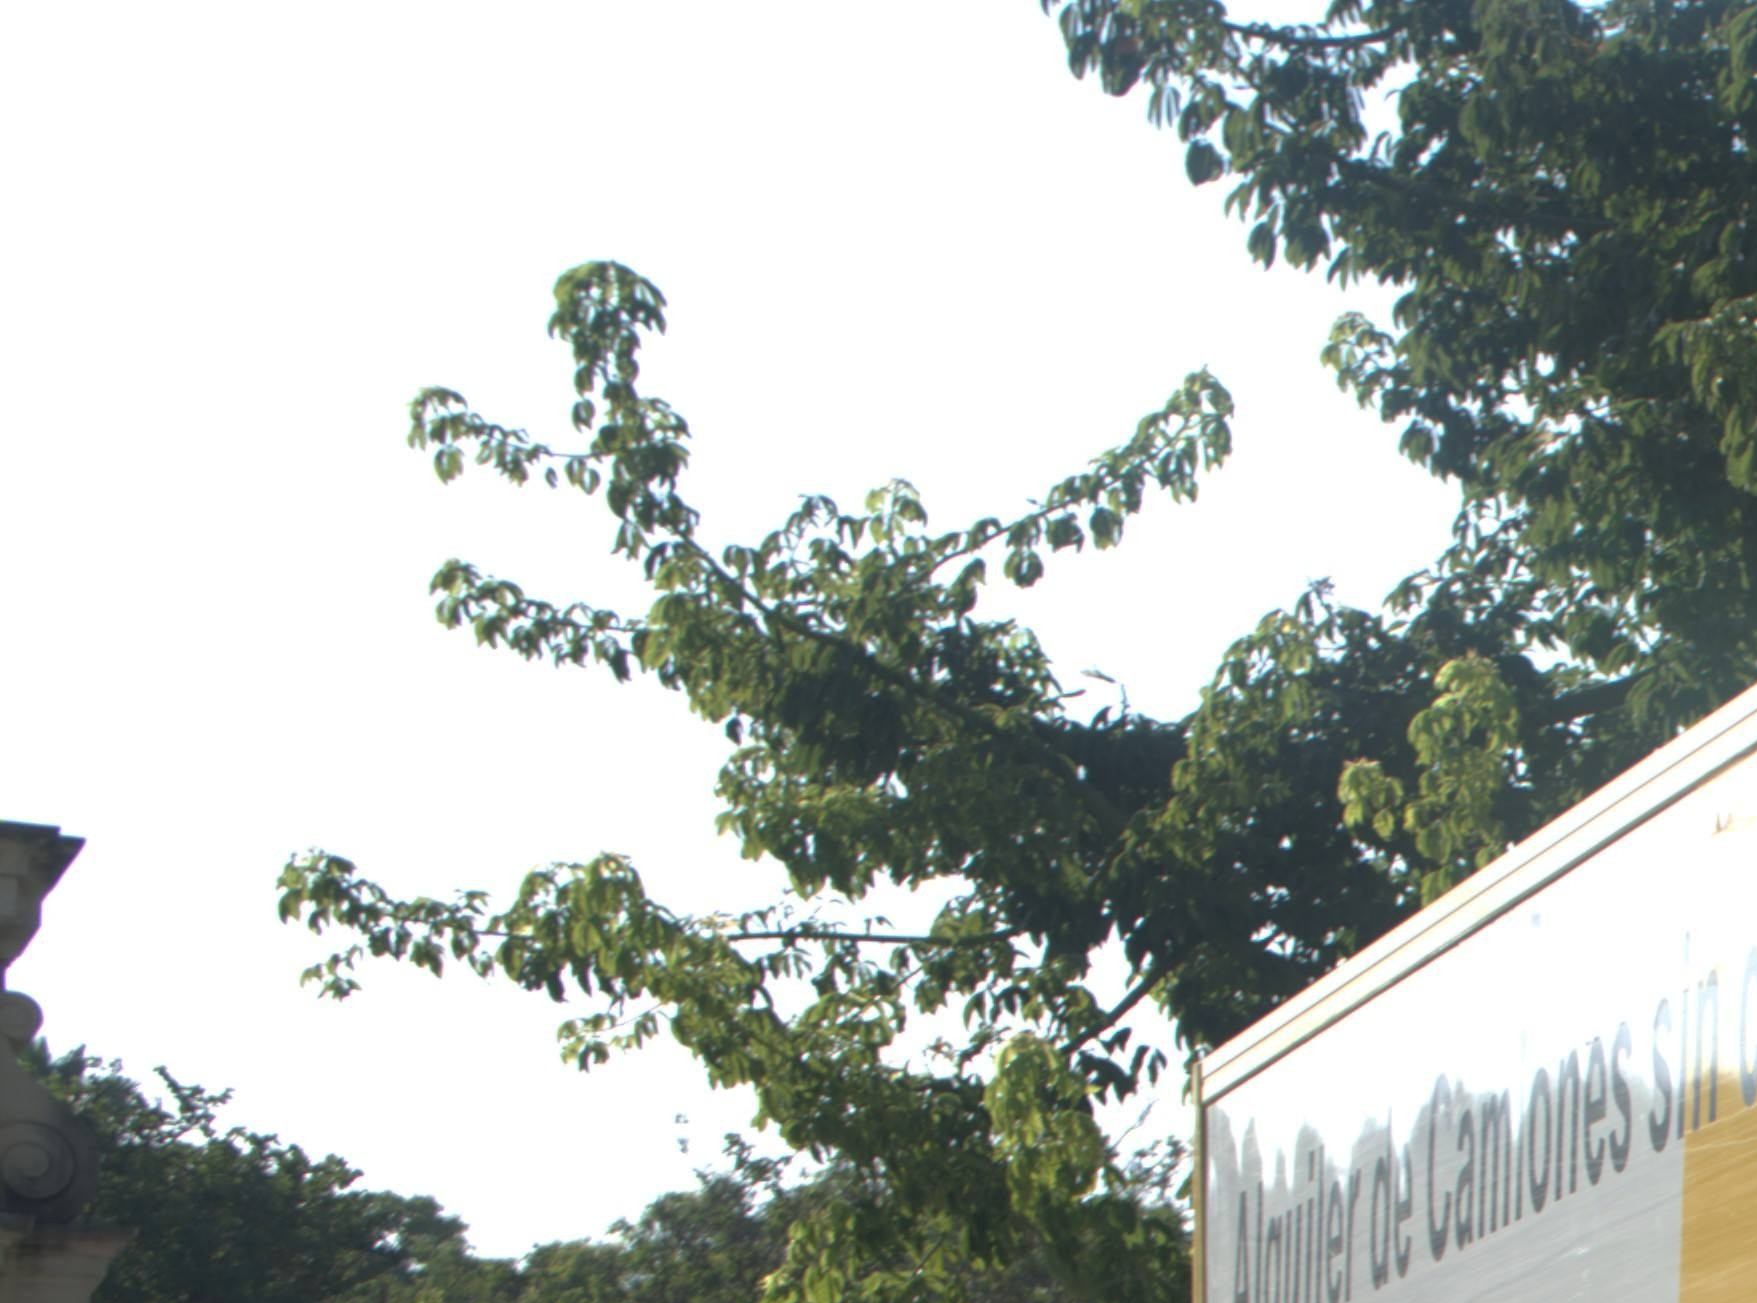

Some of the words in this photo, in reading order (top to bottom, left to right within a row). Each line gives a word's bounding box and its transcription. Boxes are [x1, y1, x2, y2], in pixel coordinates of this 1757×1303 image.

[1371, 1112, 1411, 1290] de
[1428, 1020, 1630, 1261] Camiones
[1651, 932, 1719, 1152] sin
